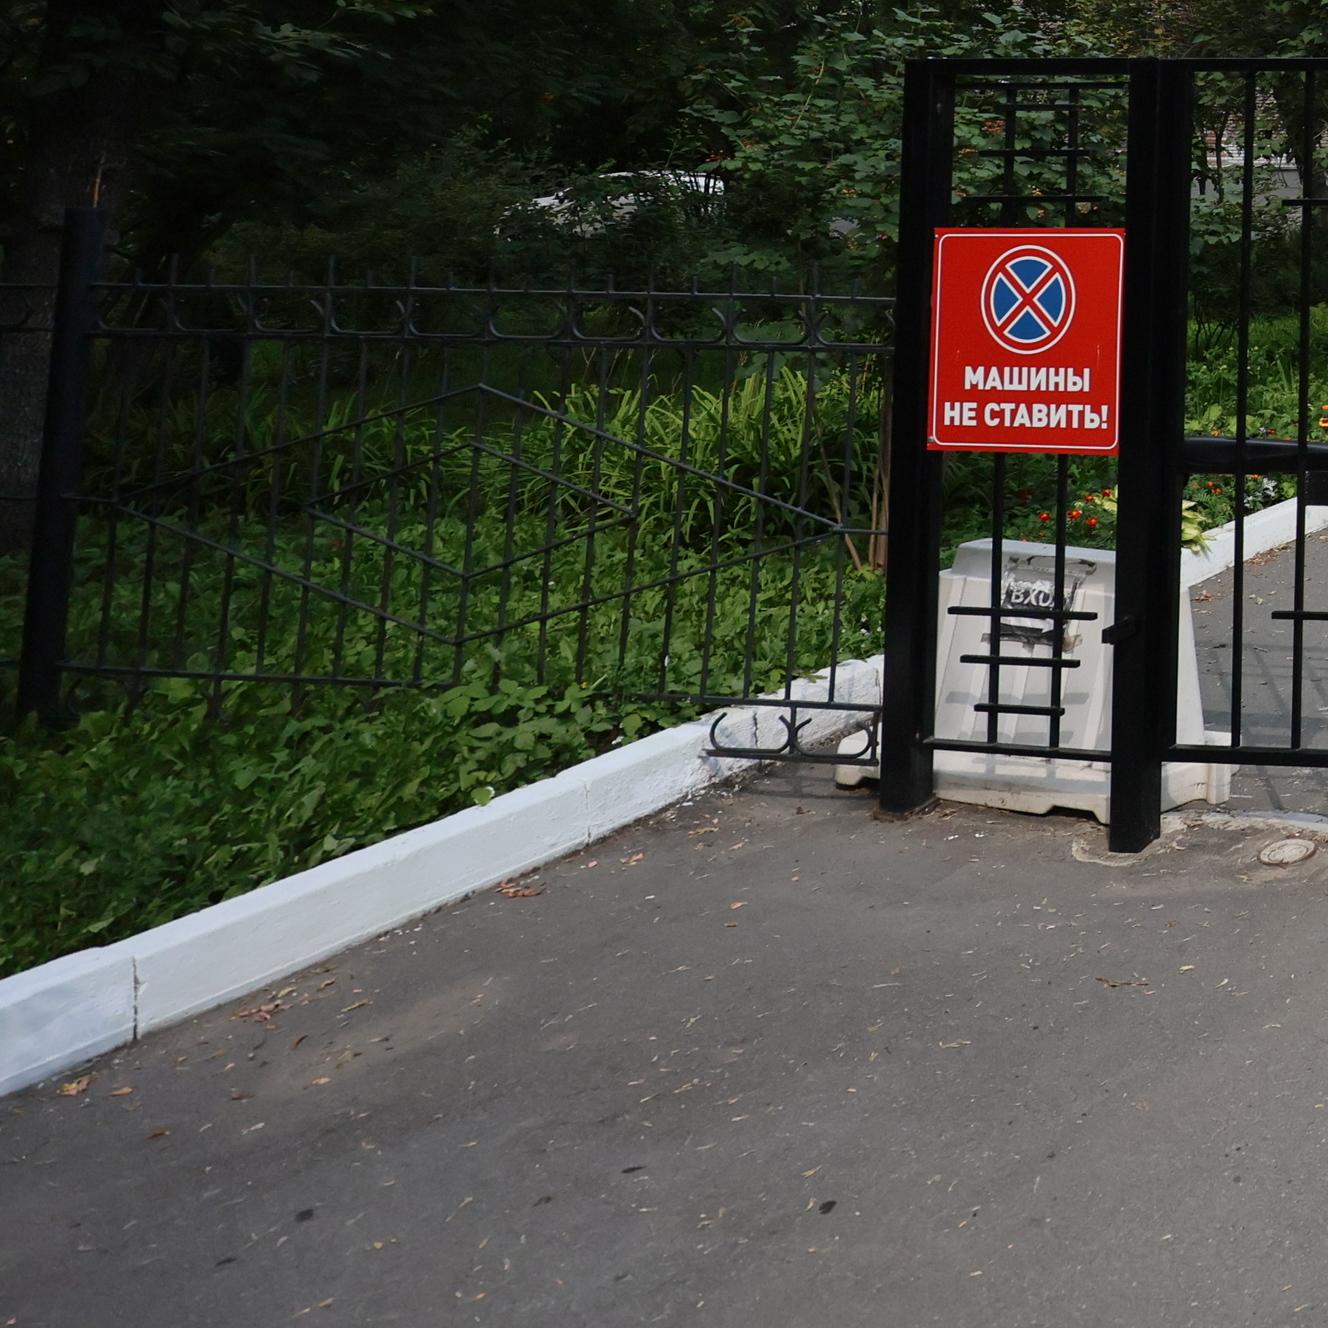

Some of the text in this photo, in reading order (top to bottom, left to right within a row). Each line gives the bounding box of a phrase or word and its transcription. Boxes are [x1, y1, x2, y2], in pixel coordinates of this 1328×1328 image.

[964, 366, 1090, 392] МАШИНЫ
[944, 401, 1108, 430] НЕ СТАВИТЬ!
